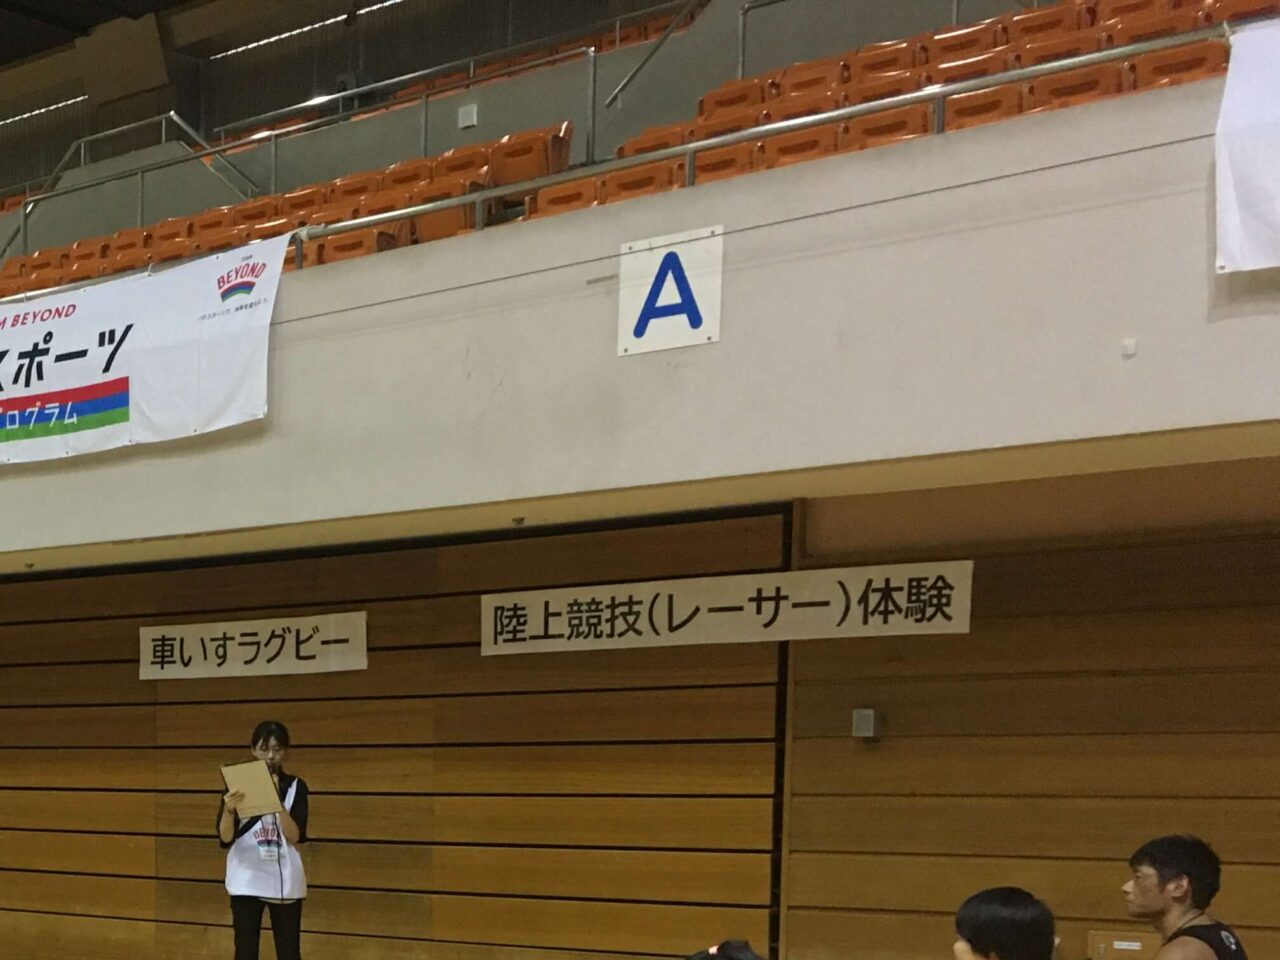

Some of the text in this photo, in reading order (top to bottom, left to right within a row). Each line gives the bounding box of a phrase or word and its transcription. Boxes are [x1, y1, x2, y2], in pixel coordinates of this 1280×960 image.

[217, 261, 267, 291] BEYOND
[633, 251, 703, 339] A
[10, 303, 77, 328] BEYOND
[149, 625, 350, 670] 車いすラグビー
